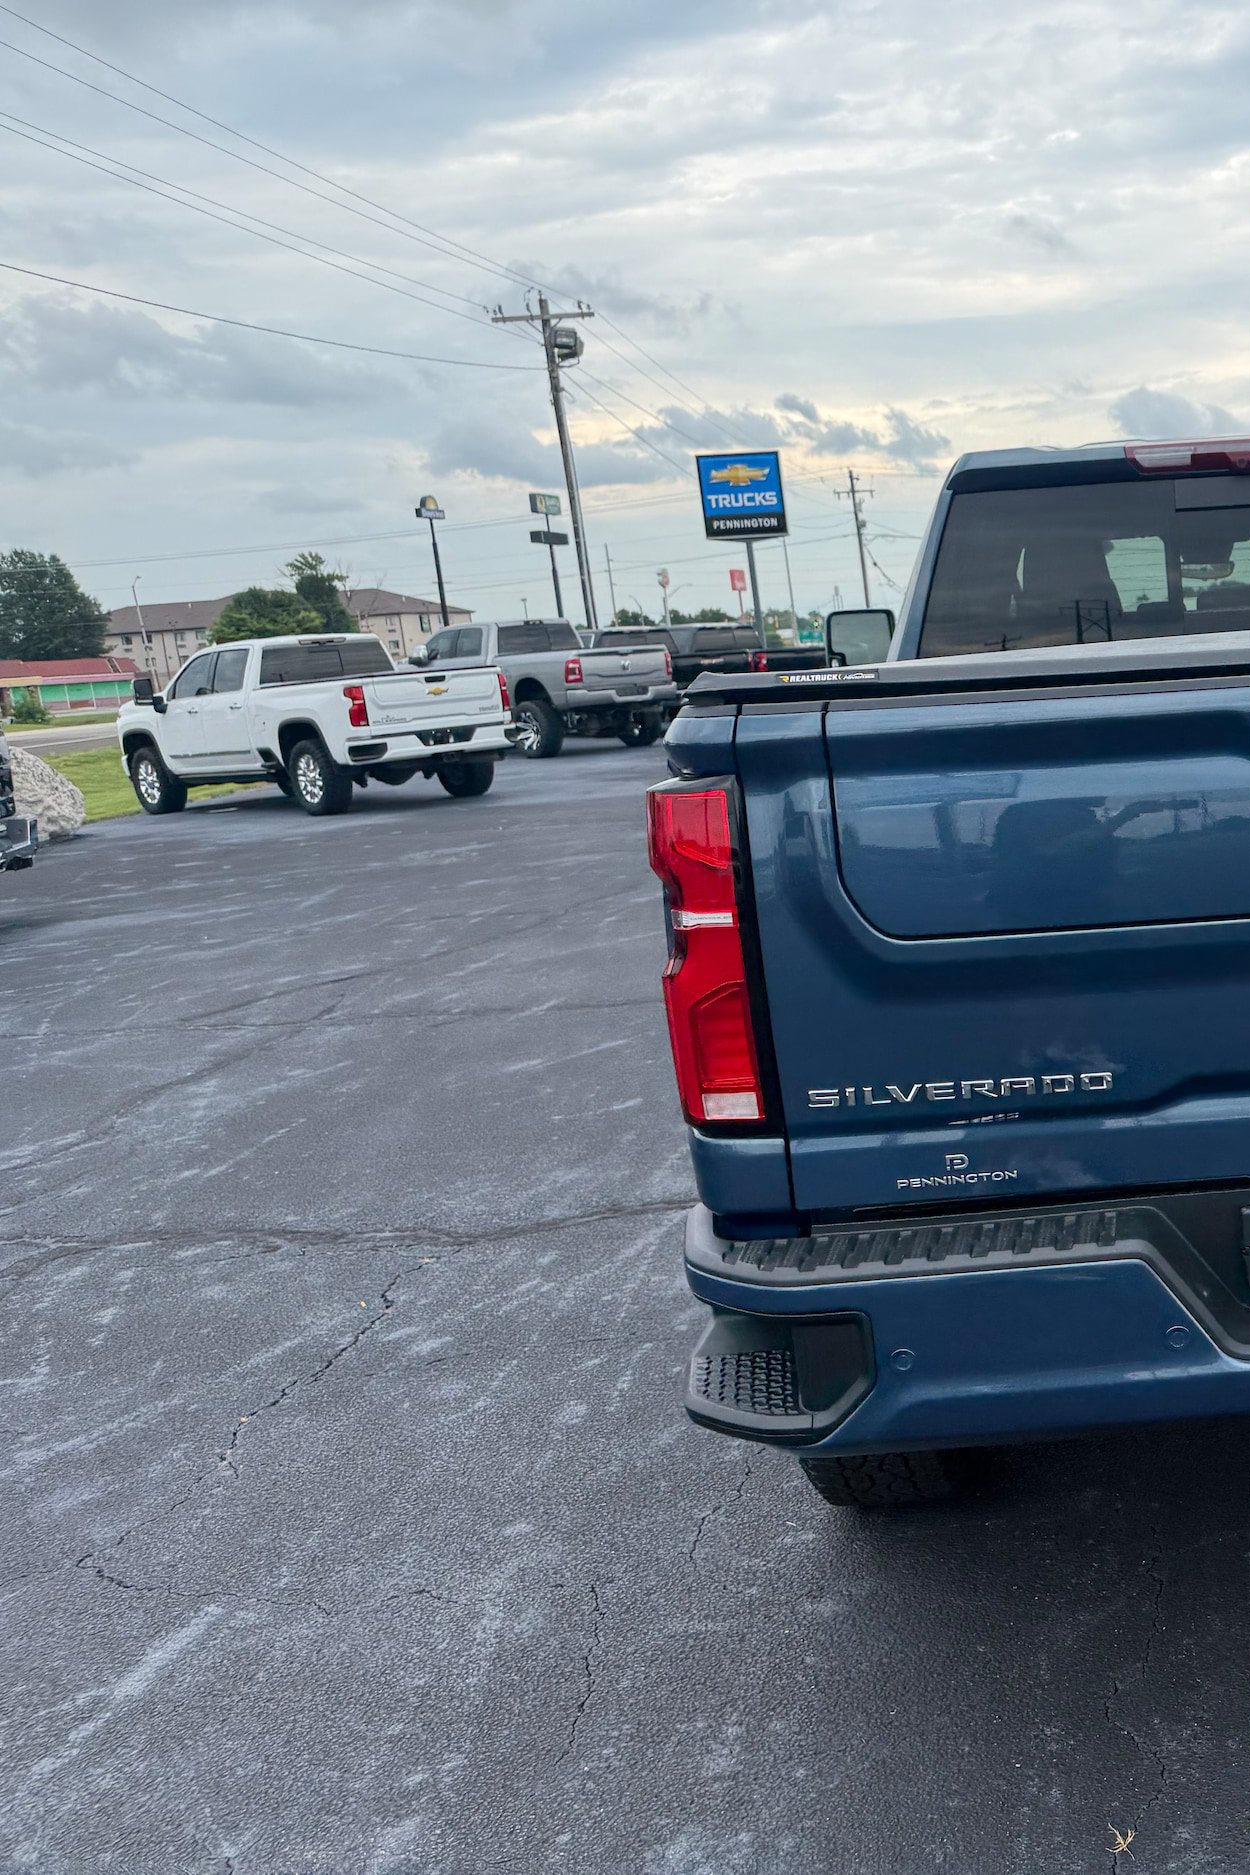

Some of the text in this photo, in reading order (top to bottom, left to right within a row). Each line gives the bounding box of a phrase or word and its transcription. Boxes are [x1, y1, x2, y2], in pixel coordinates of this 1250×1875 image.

[707, 492, 777, 508] TRUCKS
[713, 518, 777, 529] PENNINGTON
[790, 674, 838, 682] REALTRUCK
[807, 1071, 1113, 1108] SILVERADO
[896, 1169, 1018, 1189] PENNINGTON
